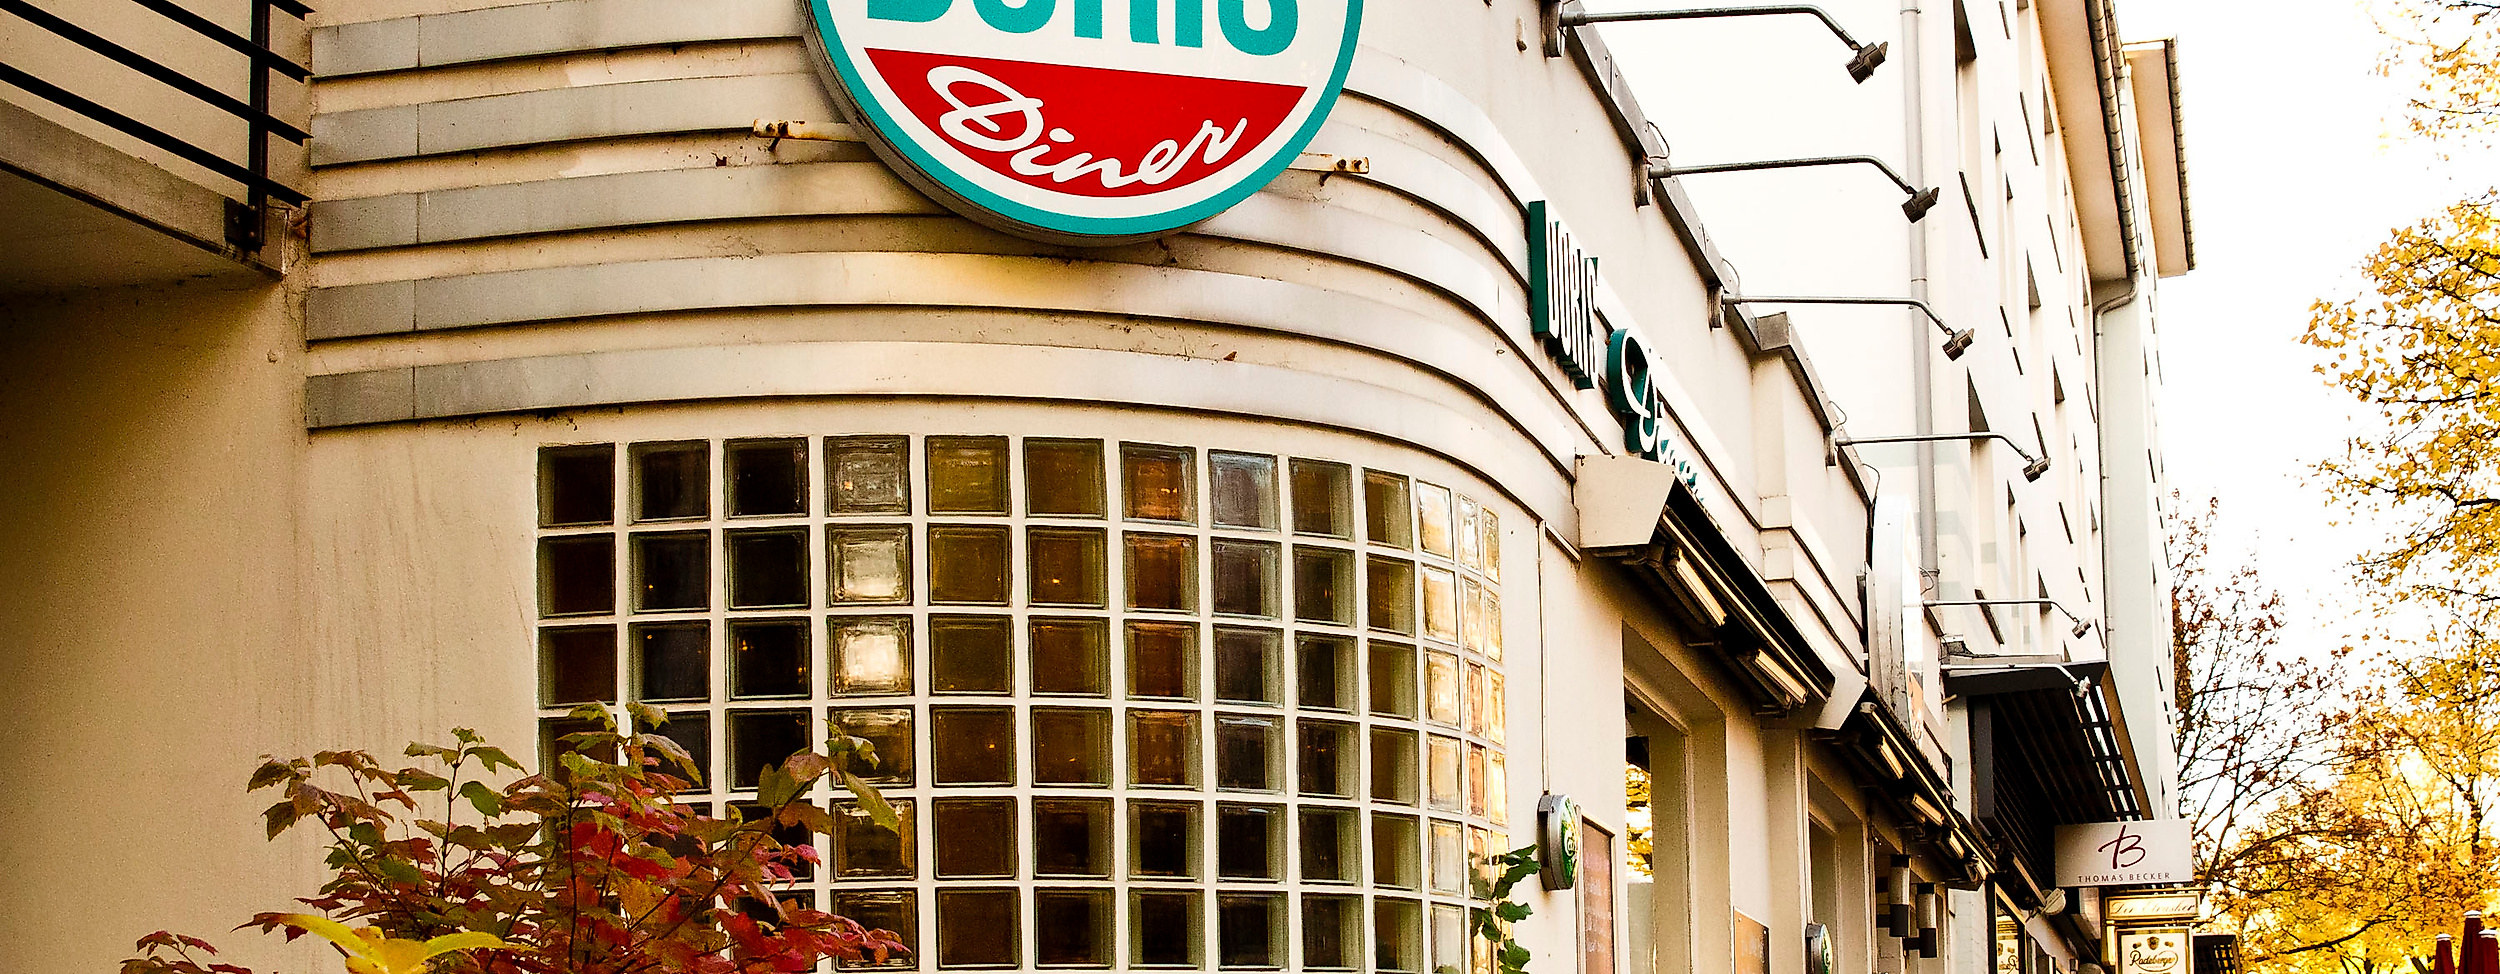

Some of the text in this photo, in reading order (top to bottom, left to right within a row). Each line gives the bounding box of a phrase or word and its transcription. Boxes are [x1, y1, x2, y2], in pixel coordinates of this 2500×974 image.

[926, 65, 1248, 189] Diner
[1527, 199, 1601, 391] DORIS
[2077, 871, 2171, 883] THOMAS BECKER
